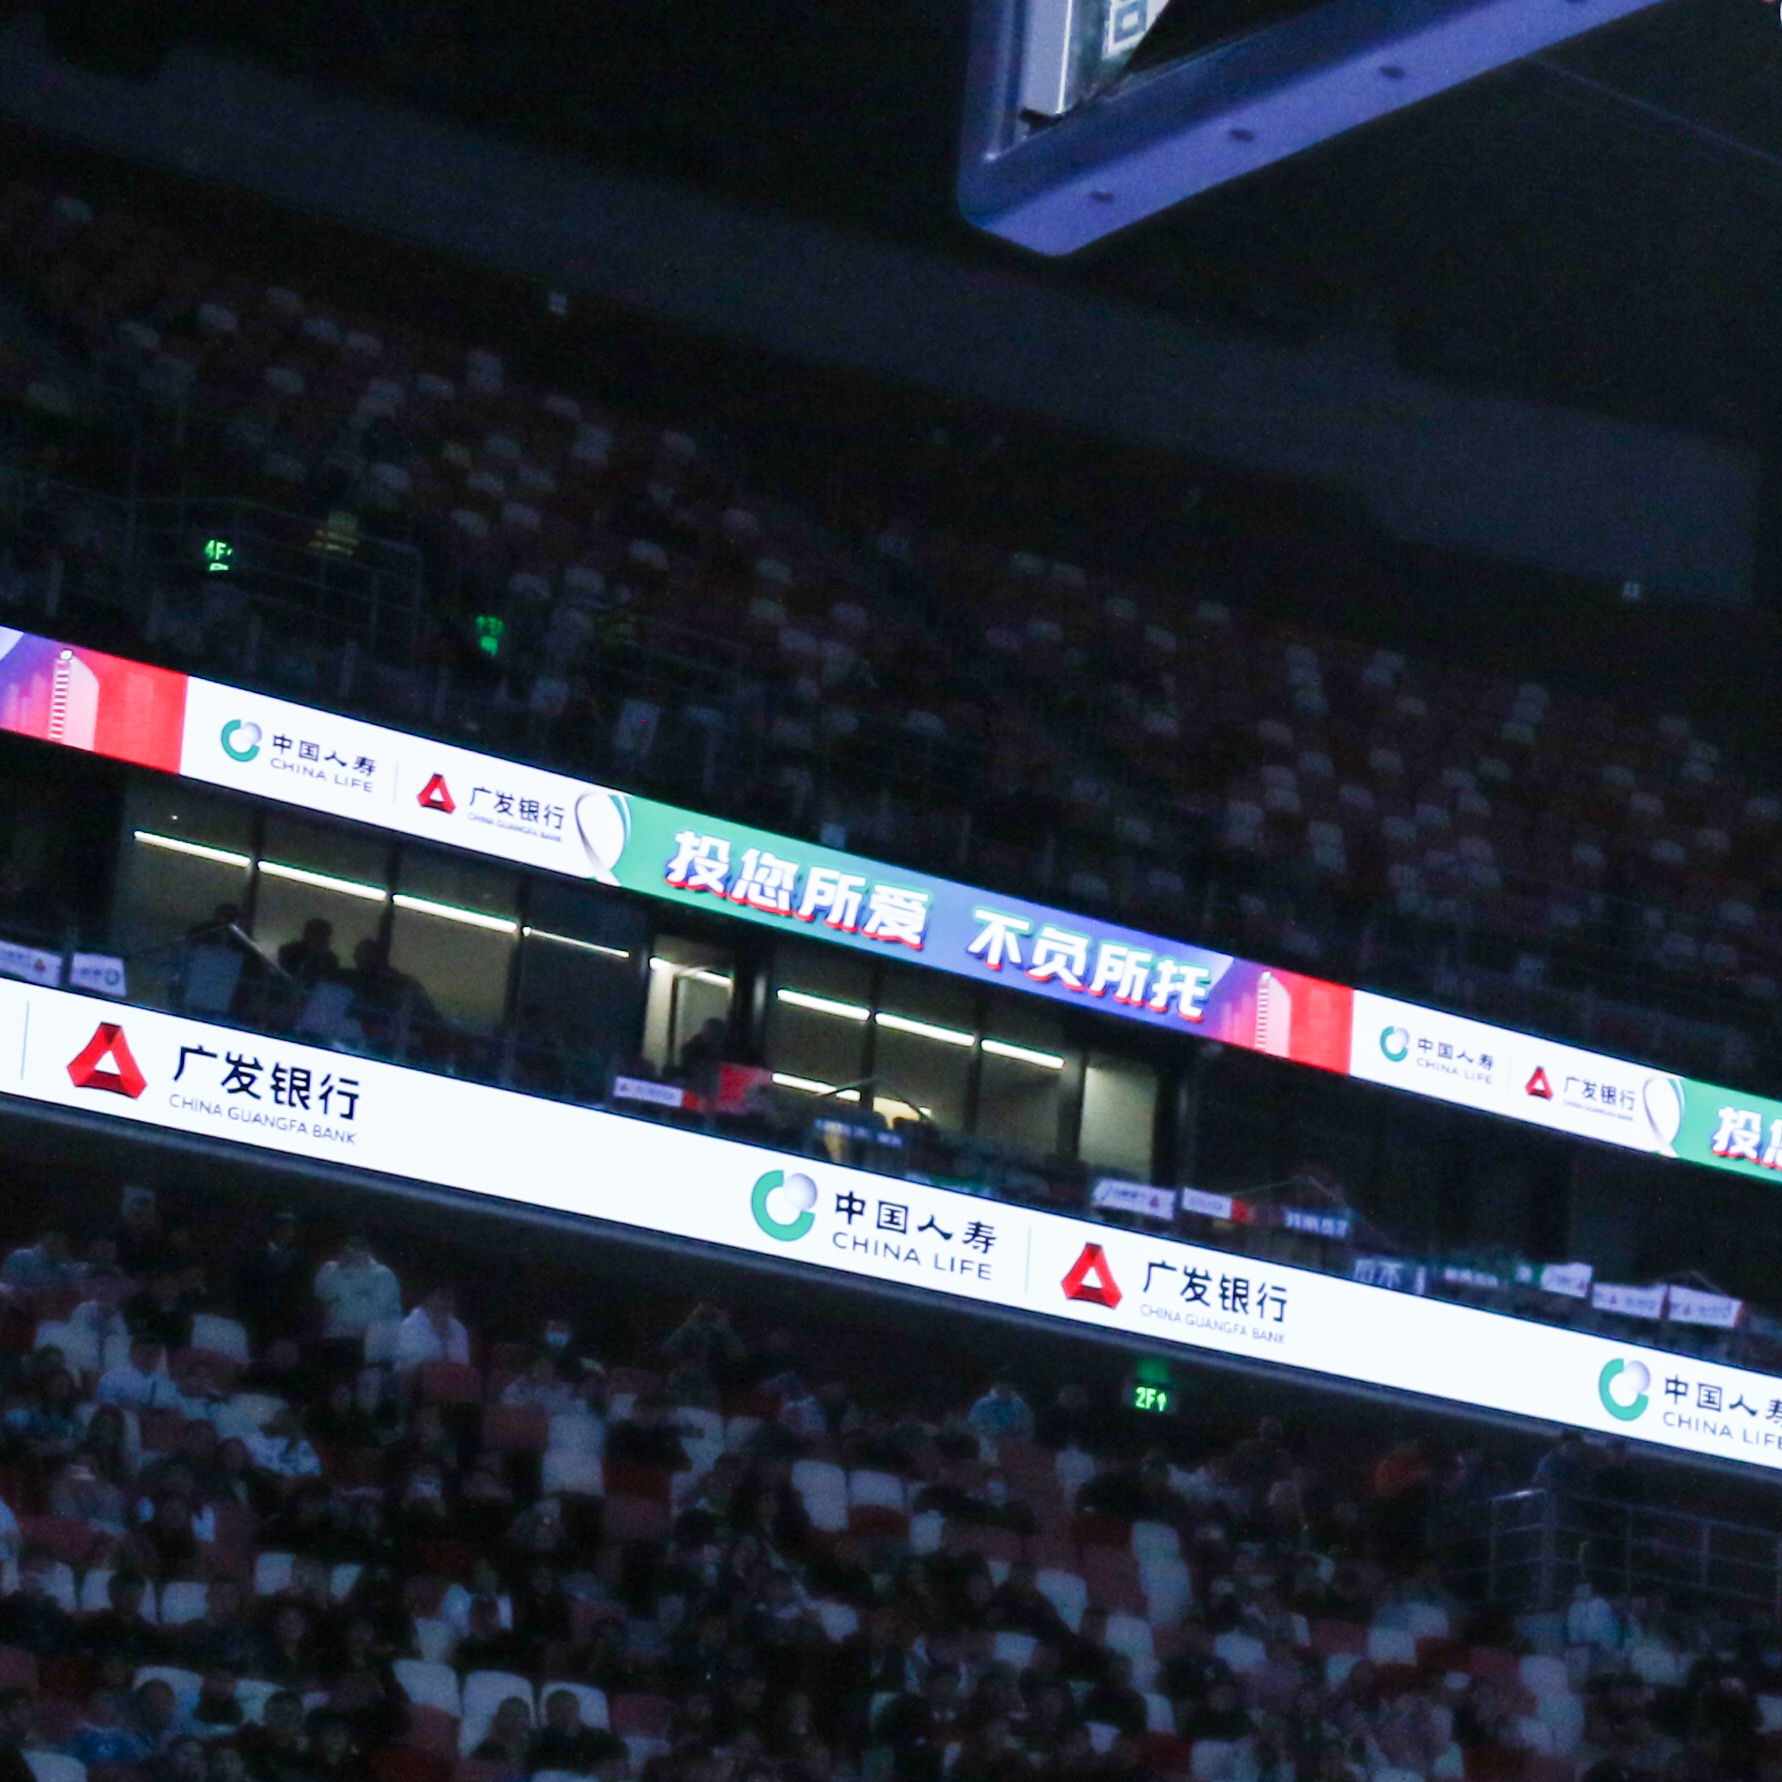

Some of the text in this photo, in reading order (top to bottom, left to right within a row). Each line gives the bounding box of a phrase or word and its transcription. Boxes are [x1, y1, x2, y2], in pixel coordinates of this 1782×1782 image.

[270, 757, 374, 794] CHINA LIFE
[272, 733, 377, 778] 中国人寿
[468, 786, 567, 832] 广发银行
[665, 828, 1212, 1021] 投您所爱 不负所托
[1416, 1056, 1493, 1085] CHINA LIFE
[1417, 1036, 1495, 1071] 中国人寿
[172, 1043, 362, 1121] 广发银行
[1563, 1075, 1636, 1111] 广发银行
[168, 1093, 357, 1146] CHINA GUANGFA BANK
[833, 1190, 998, 1256] 中国人寿
[831, 1229, 994, 1282] CHINA LIFE
[1142, 1257, 1289, 1325] 广发银行
[1139, 1301, 1288, 1346] CHINA GUANGFA BANK
[1135, 1386, 1157, 1410] 2F
[1662, 1410, 1733, 1440] CHINA
